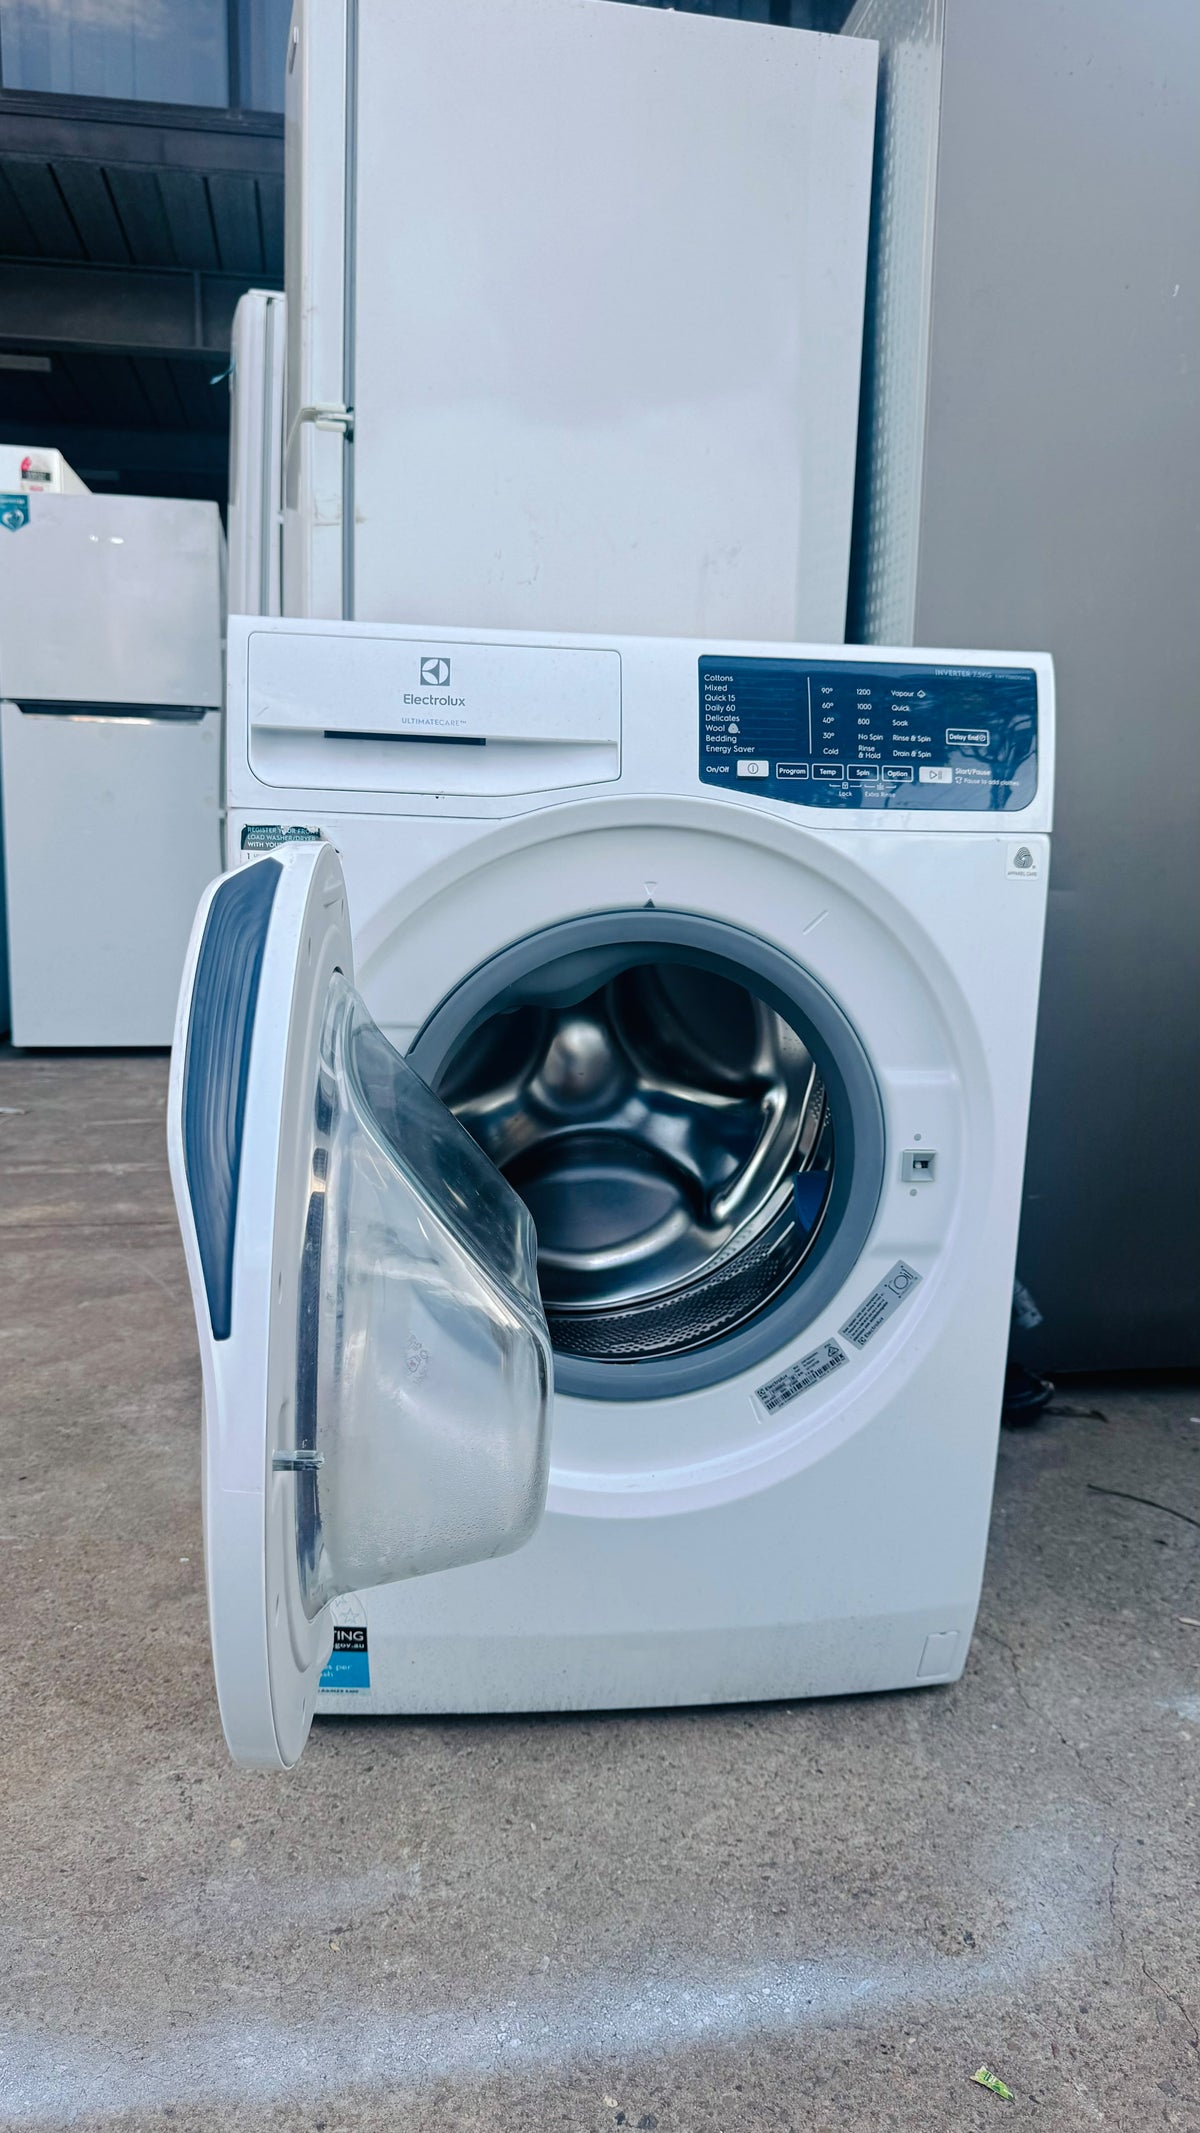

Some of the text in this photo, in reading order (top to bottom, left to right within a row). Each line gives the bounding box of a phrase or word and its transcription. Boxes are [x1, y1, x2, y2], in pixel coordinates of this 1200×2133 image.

[935, 669, 970, 678] INVERTER
[704, 674, 733, 682] Cottons
[403, 693, 466, 706] Electrolux
[705, 704, 724, 712] Daily
[705, 714, 740, 722] Delicates
[706, 735, 737, 743] Bedding
[917, 735, 931, 743] Spin
[706, 745, 731, 754] Energy
[334, 1630, 364, 1641] ING
